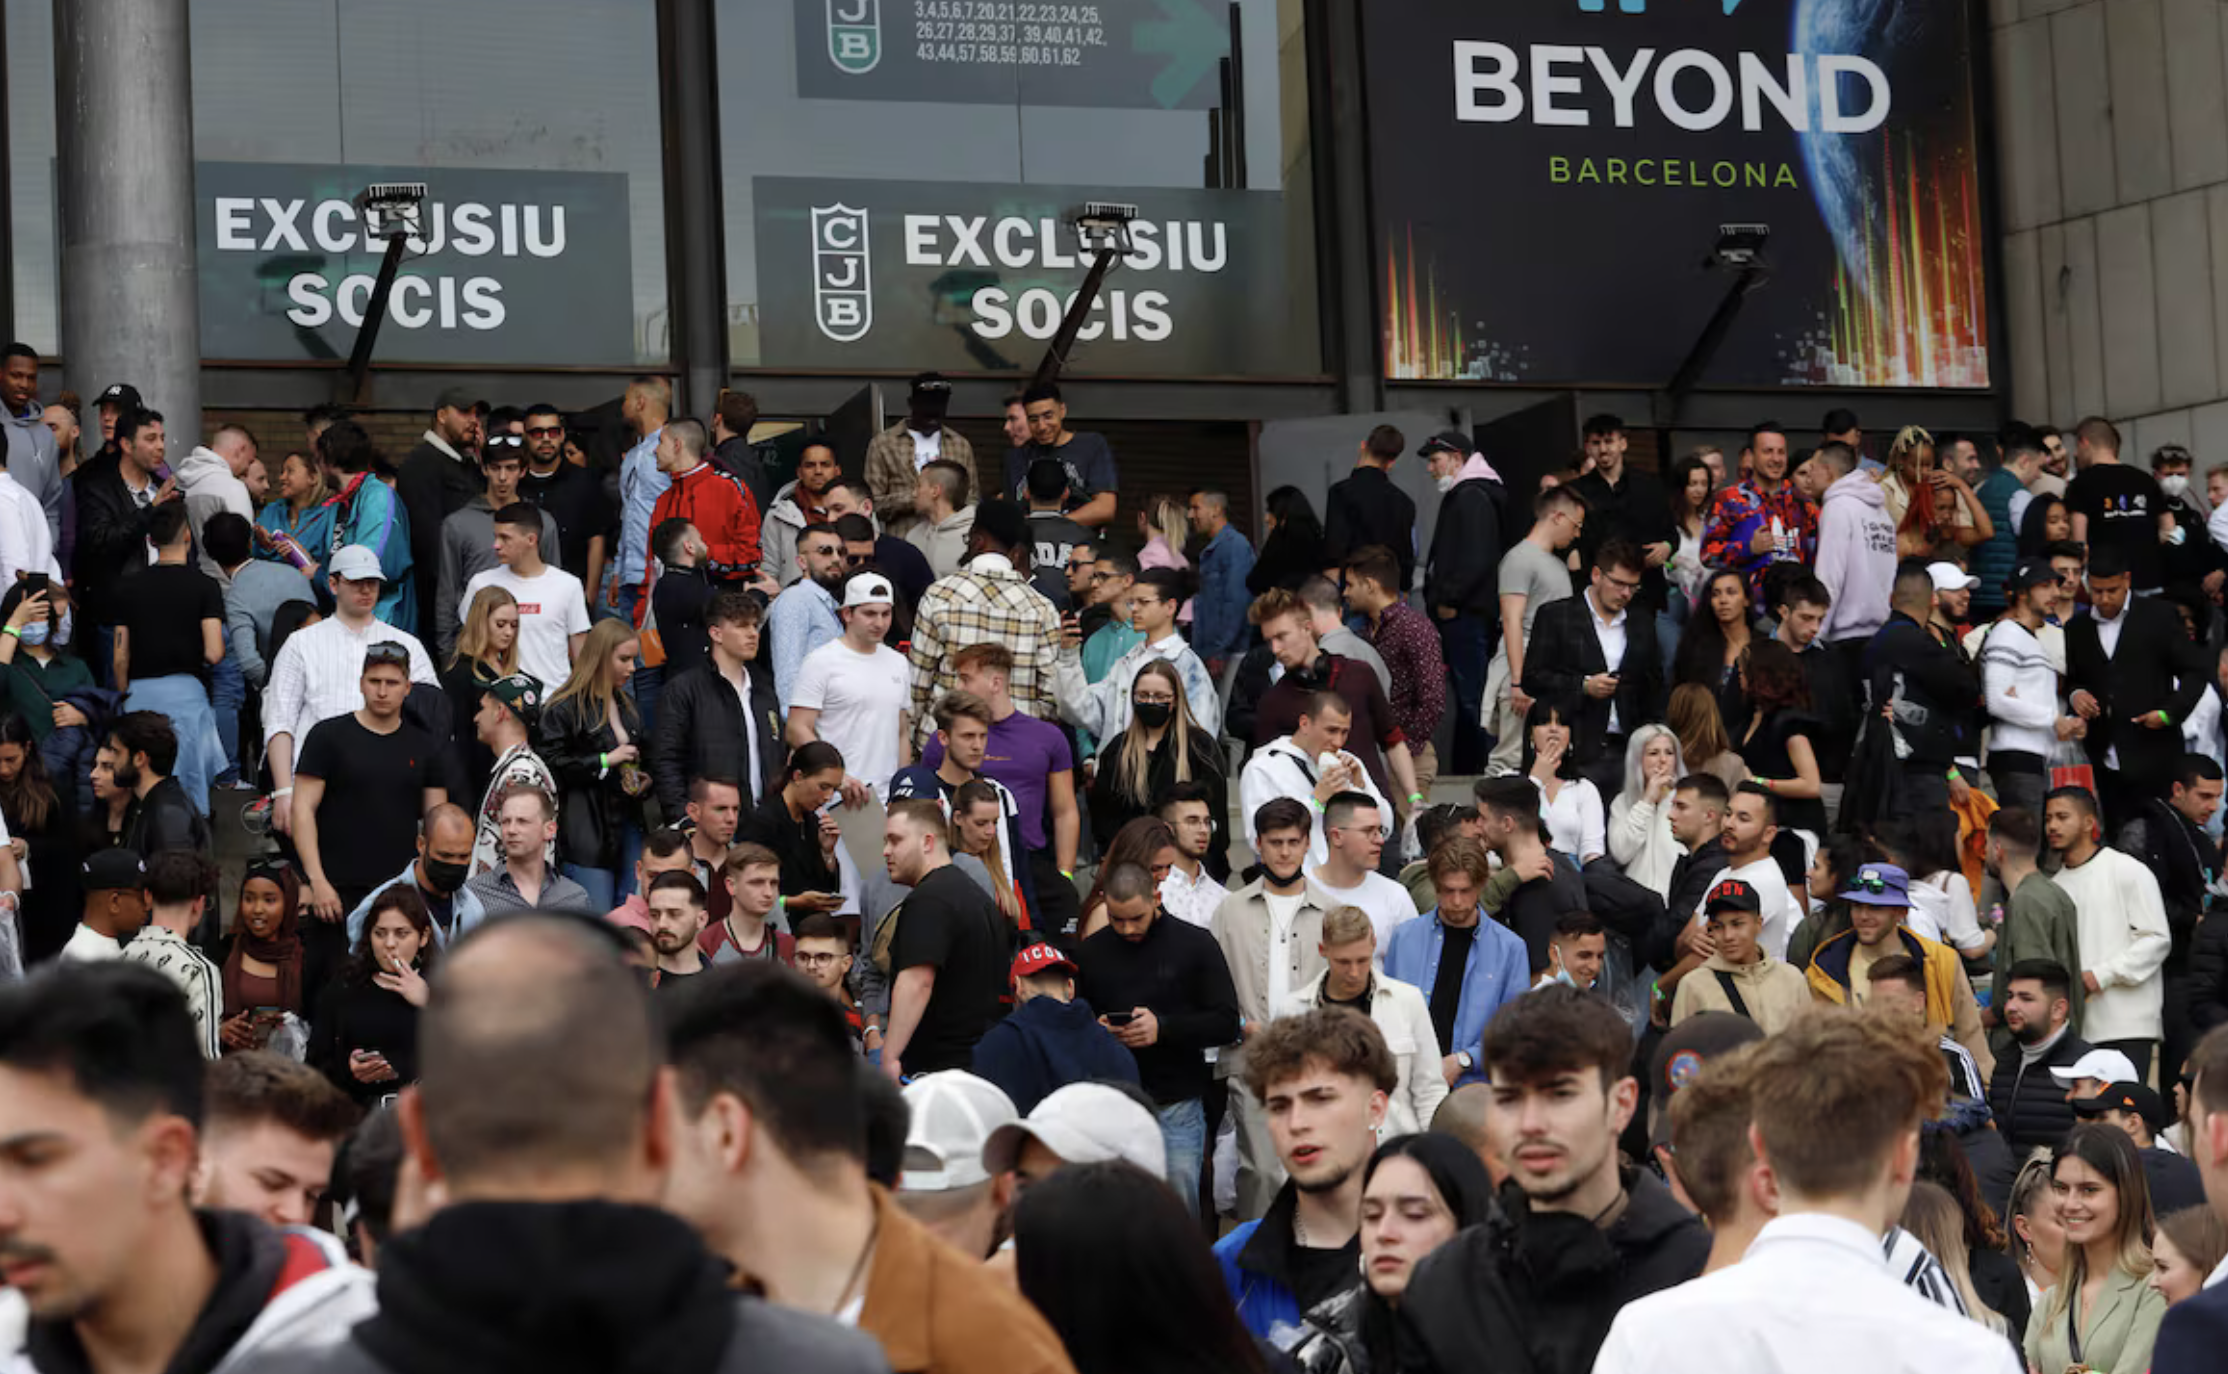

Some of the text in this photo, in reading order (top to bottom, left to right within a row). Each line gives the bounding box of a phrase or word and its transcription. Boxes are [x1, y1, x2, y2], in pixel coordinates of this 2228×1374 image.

[1452, 40, 1891, 134] BEYOND
[1549, 156, 1798, 189] BARCELONA
[214, 197, 567, 257] EXCLUSIU
[286, 271, 507, 331] SOCIS
